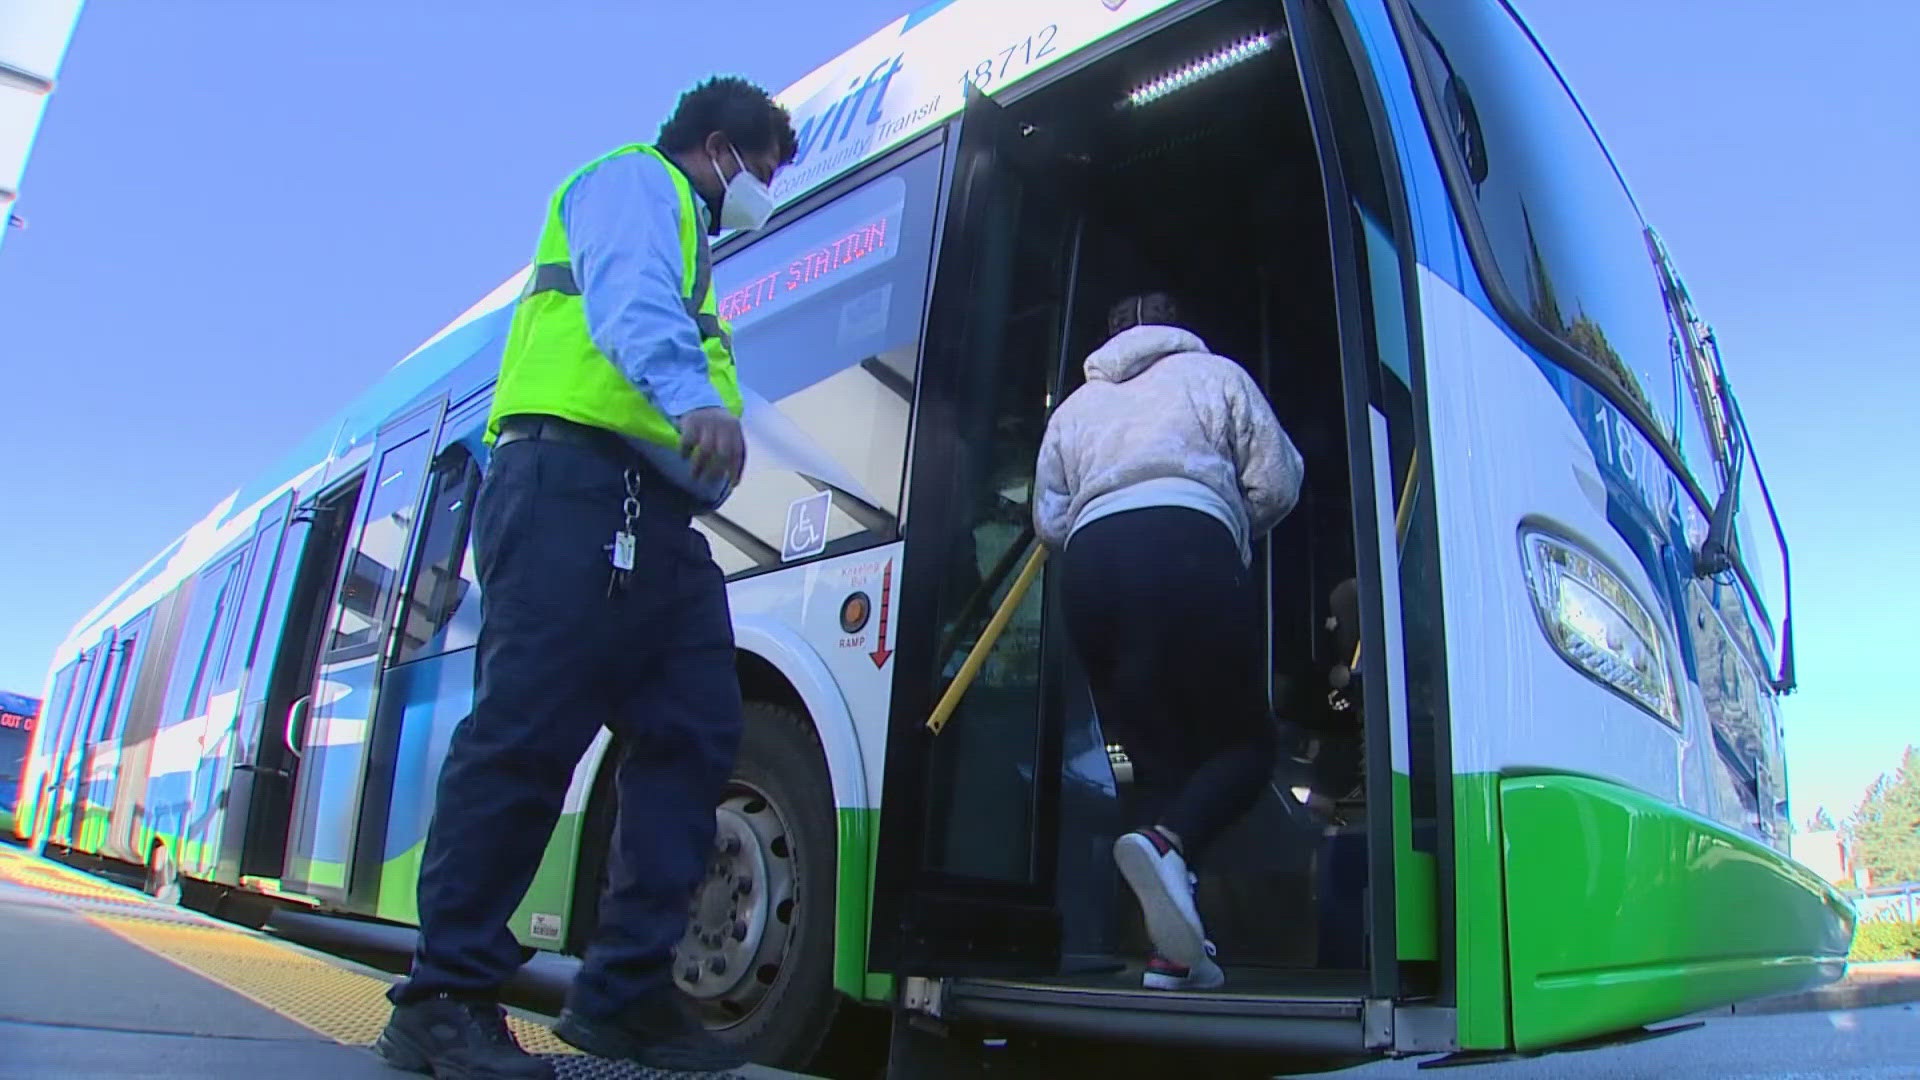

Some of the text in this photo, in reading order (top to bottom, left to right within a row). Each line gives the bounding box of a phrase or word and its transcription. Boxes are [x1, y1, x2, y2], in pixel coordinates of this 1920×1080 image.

[958, 24, 1058, 97] 18712
[878, 95, 941, 142] Transit
[786, 218, 887, 290] STATION
[840, 637, 865, 648] RAMP
[1, 713, 23, 728] OUT
